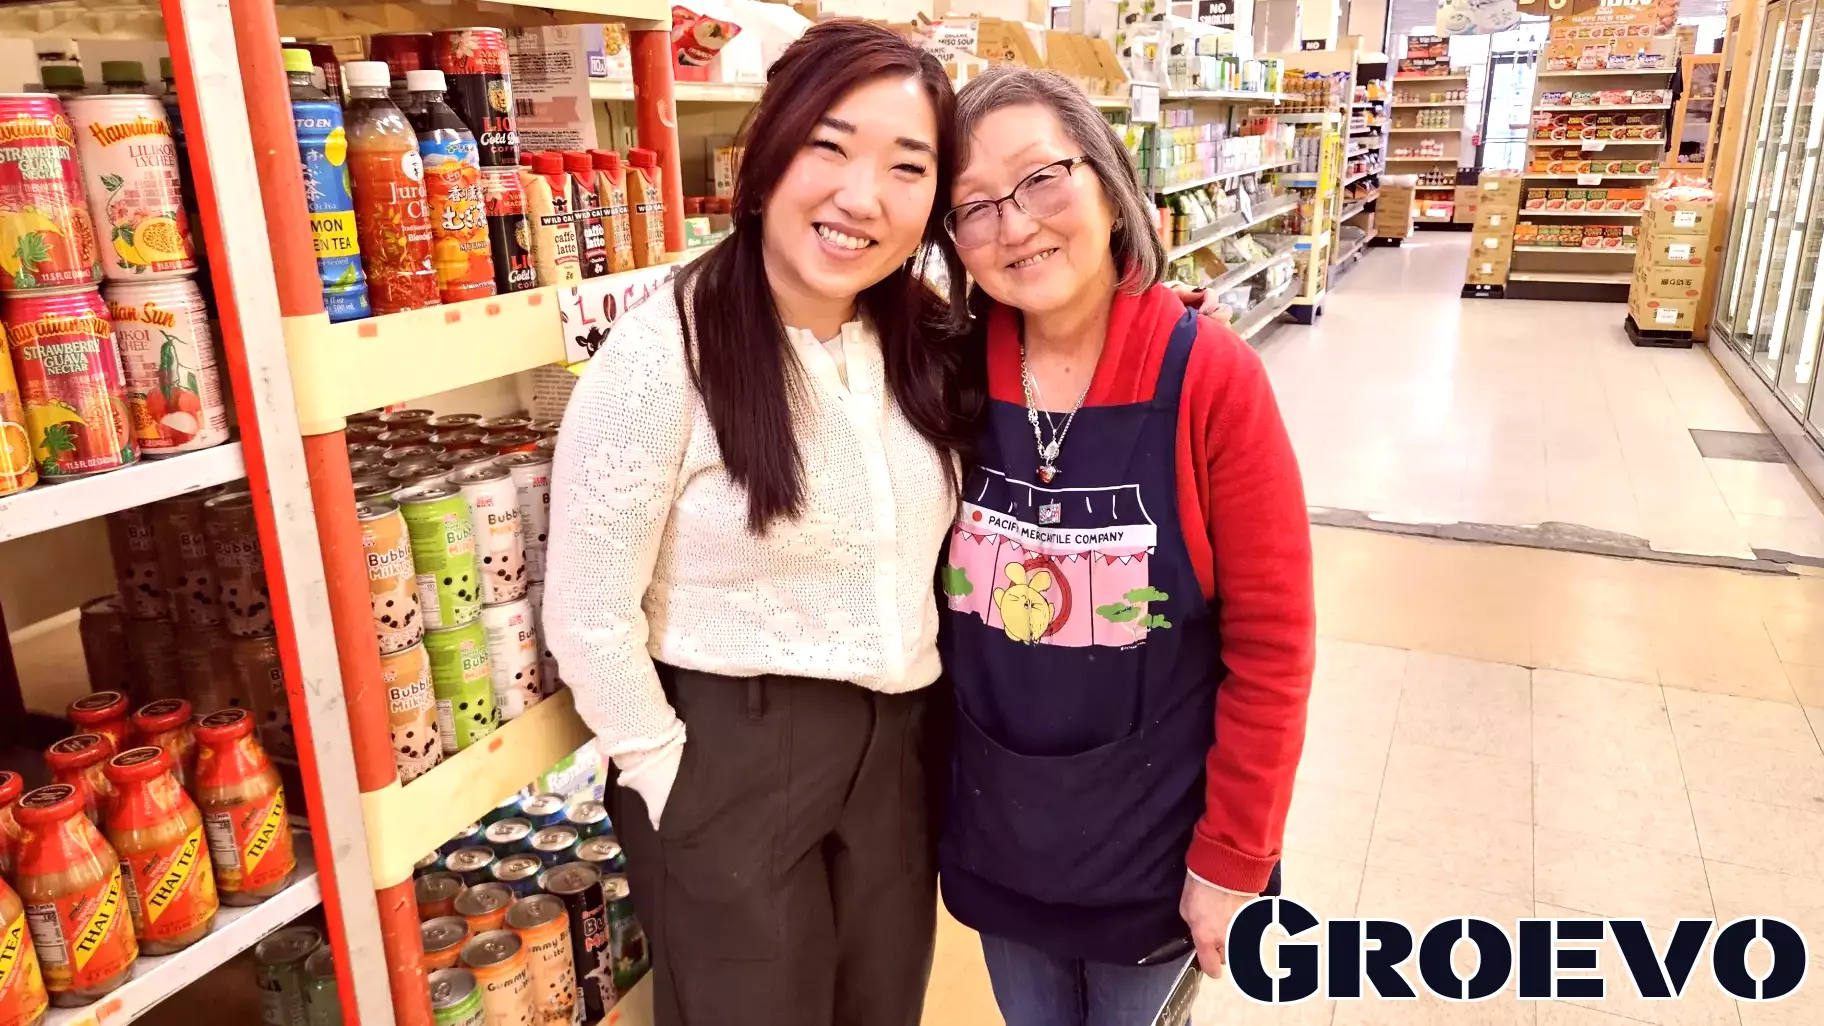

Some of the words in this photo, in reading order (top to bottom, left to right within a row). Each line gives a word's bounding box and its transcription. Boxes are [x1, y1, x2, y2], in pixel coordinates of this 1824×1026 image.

[1209, 2, 1227, 14] NO
[1199, 13, 1235, 26] SMOKING
[1571, 15, 1596, 23] HAPPY
[1305, 40, 1321, 50] NO
[134, 155, 175, 167] LYCHEE
[543, 216, 562, 225] WILD
[574, 211, 591, 220] WILD
[332, 236, 353, 251] TEA
[556, 244, 576, 255] latte
[140, 301, 176, 329] Sun
[23, 338, 101, 361] STRAWBERRY
[43, 352, 89, 367] GUAVA
[47, 363, 89, 376] NECTAR
[1075, 531, 1124, 545] COMPANY
[246, 823, 277, 858] THAI
[148, 871, 183, 908] THAI
[177, 836, 199, 867] TEA
[76, 912, 111, 953] THAI
[104, 873, 121, 907] TEA
